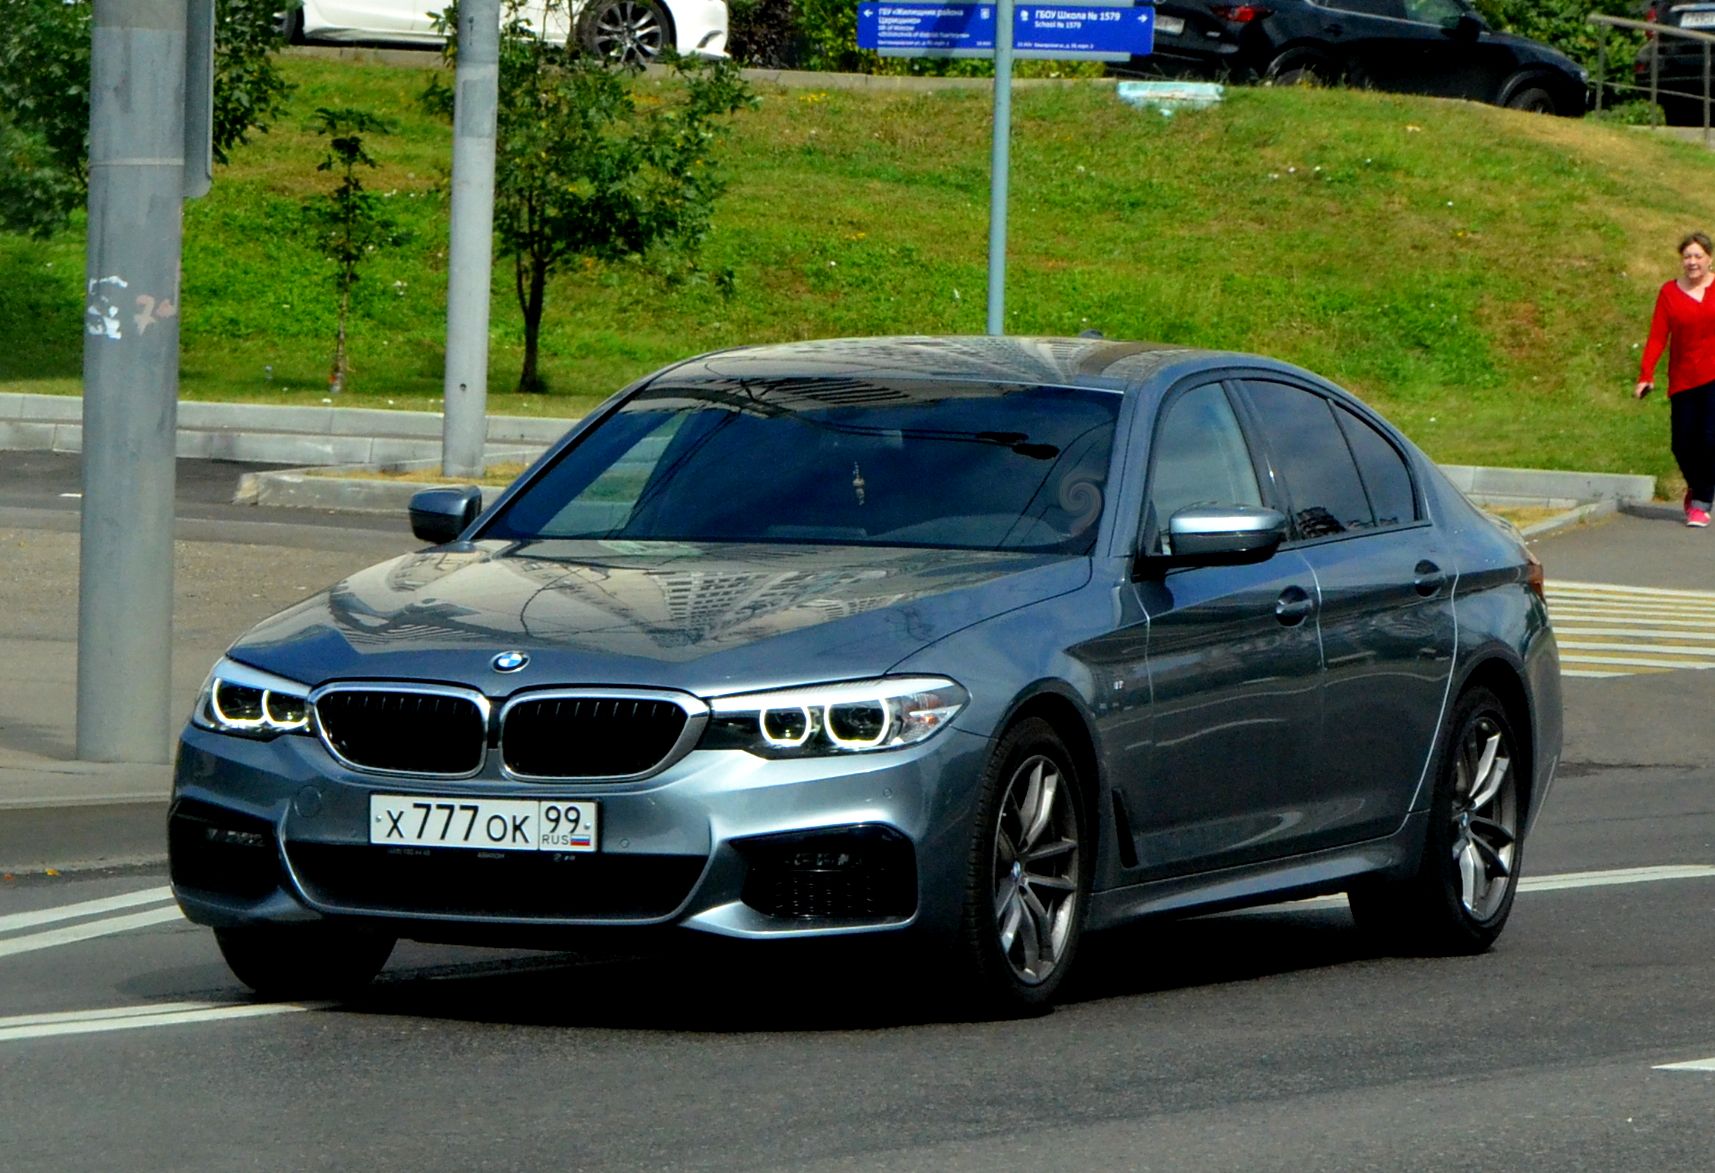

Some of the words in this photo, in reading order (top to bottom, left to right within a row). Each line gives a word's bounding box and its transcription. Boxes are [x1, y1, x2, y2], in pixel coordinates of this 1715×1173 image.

[1035, 10, 1056, 19] ГБОУ
[1057, 11, 1086, 20] Школа
[1100, 12, 1121, 21] 1579
[545, 806, 581, 834] 99
[541, 834, 570, 846] RUS
